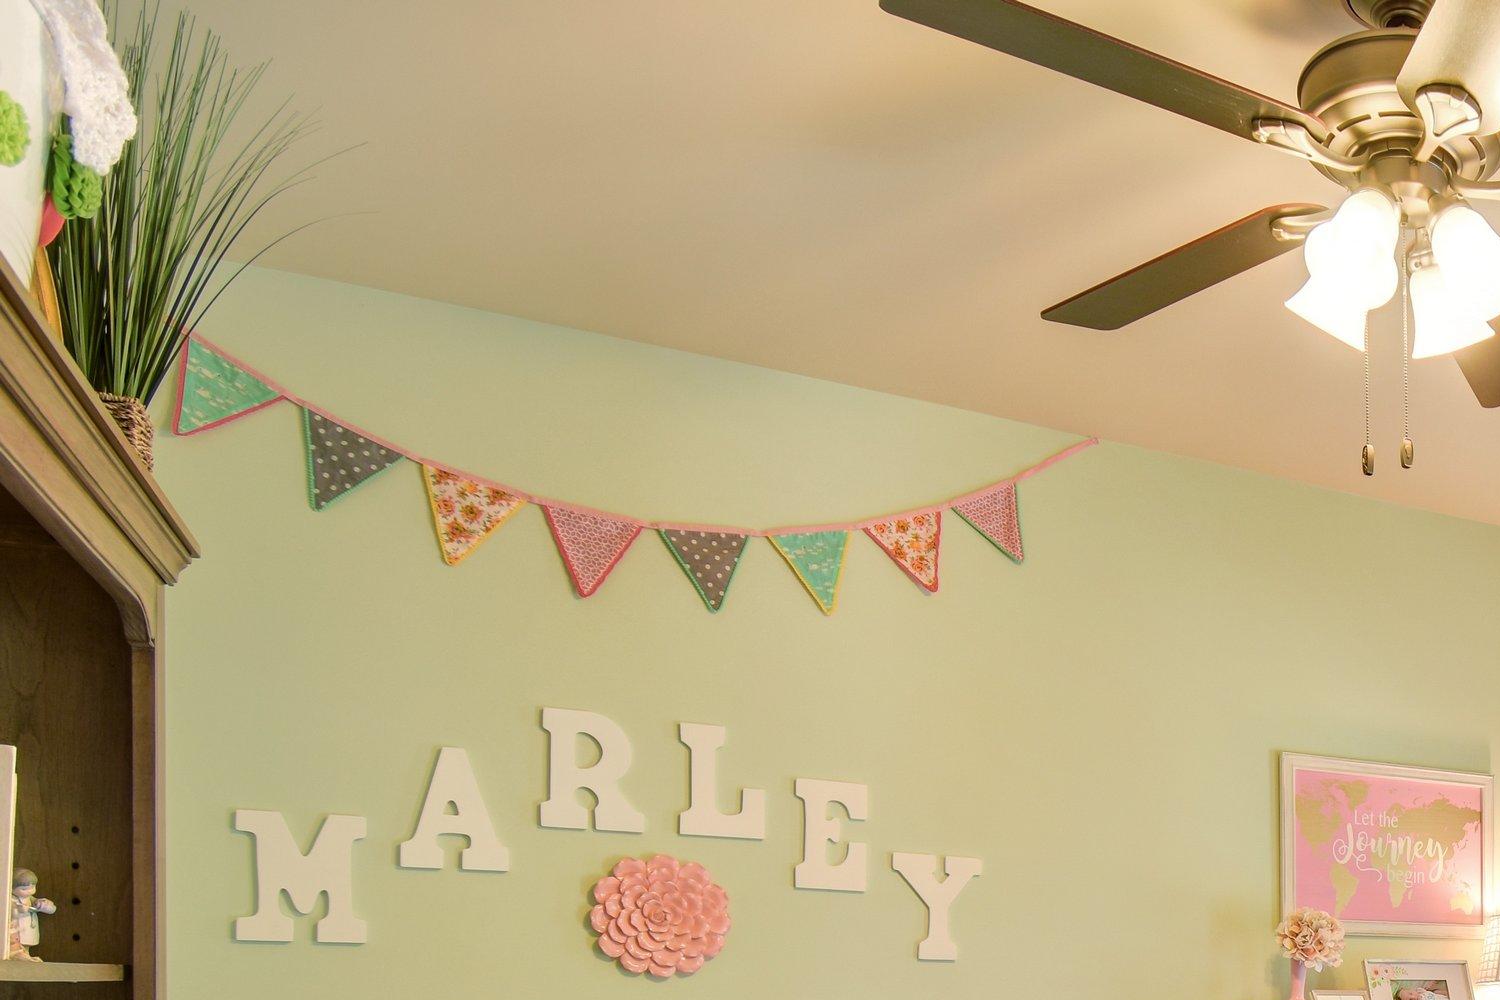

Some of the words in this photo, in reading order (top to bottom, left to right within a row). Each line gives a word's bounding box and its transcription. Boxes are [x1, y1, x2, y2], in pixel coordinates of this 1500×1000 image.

[235, 706, 981, 961] MARLEY
[1353, 810, 1375, 826] Let
[1379, 811, 1399, 828] the
[1333, 823, 1448, 882] Journey
[1387, 864, 1424, 888] begin
